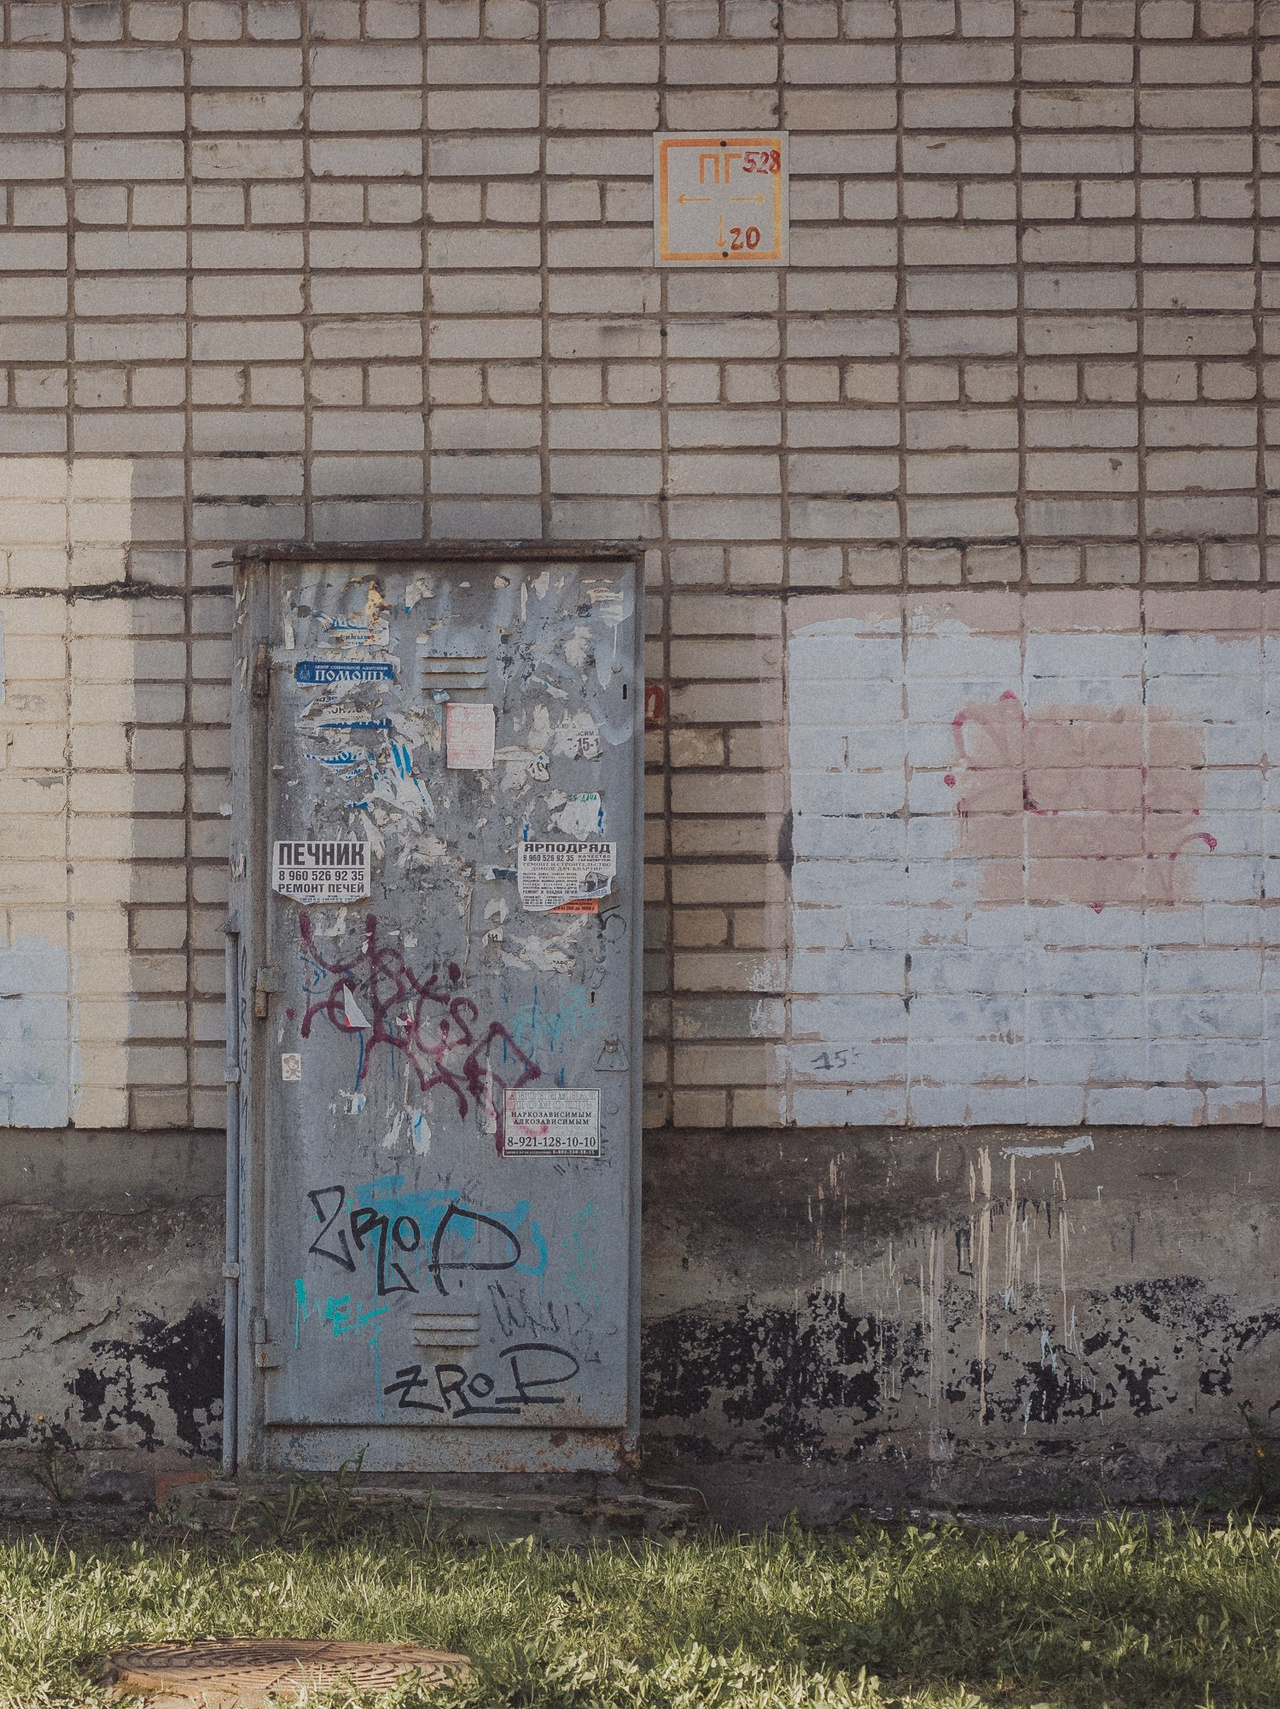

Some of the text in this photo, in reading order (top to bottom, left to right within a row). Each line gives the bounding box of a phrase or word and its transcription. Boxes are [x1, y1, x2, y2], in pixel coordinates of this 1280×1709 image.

[699, 149, 781, 184] ПГ 528
[729, 226, 762, 250] 20
[524, 843, 611, 854] ЯРПОДРЯД
[278, 843, 364, 866] ПЕЧНИК
[278, 870, 364, 881] 8 960 526 92 35
[278, 882, 365, 893] РЕМОНТ ПЕЧЕЙ
[515, 1100, 593, 1111] ПОМОЩЬ
[507, 1136, 596, 1148] 8-921-128-10-10
